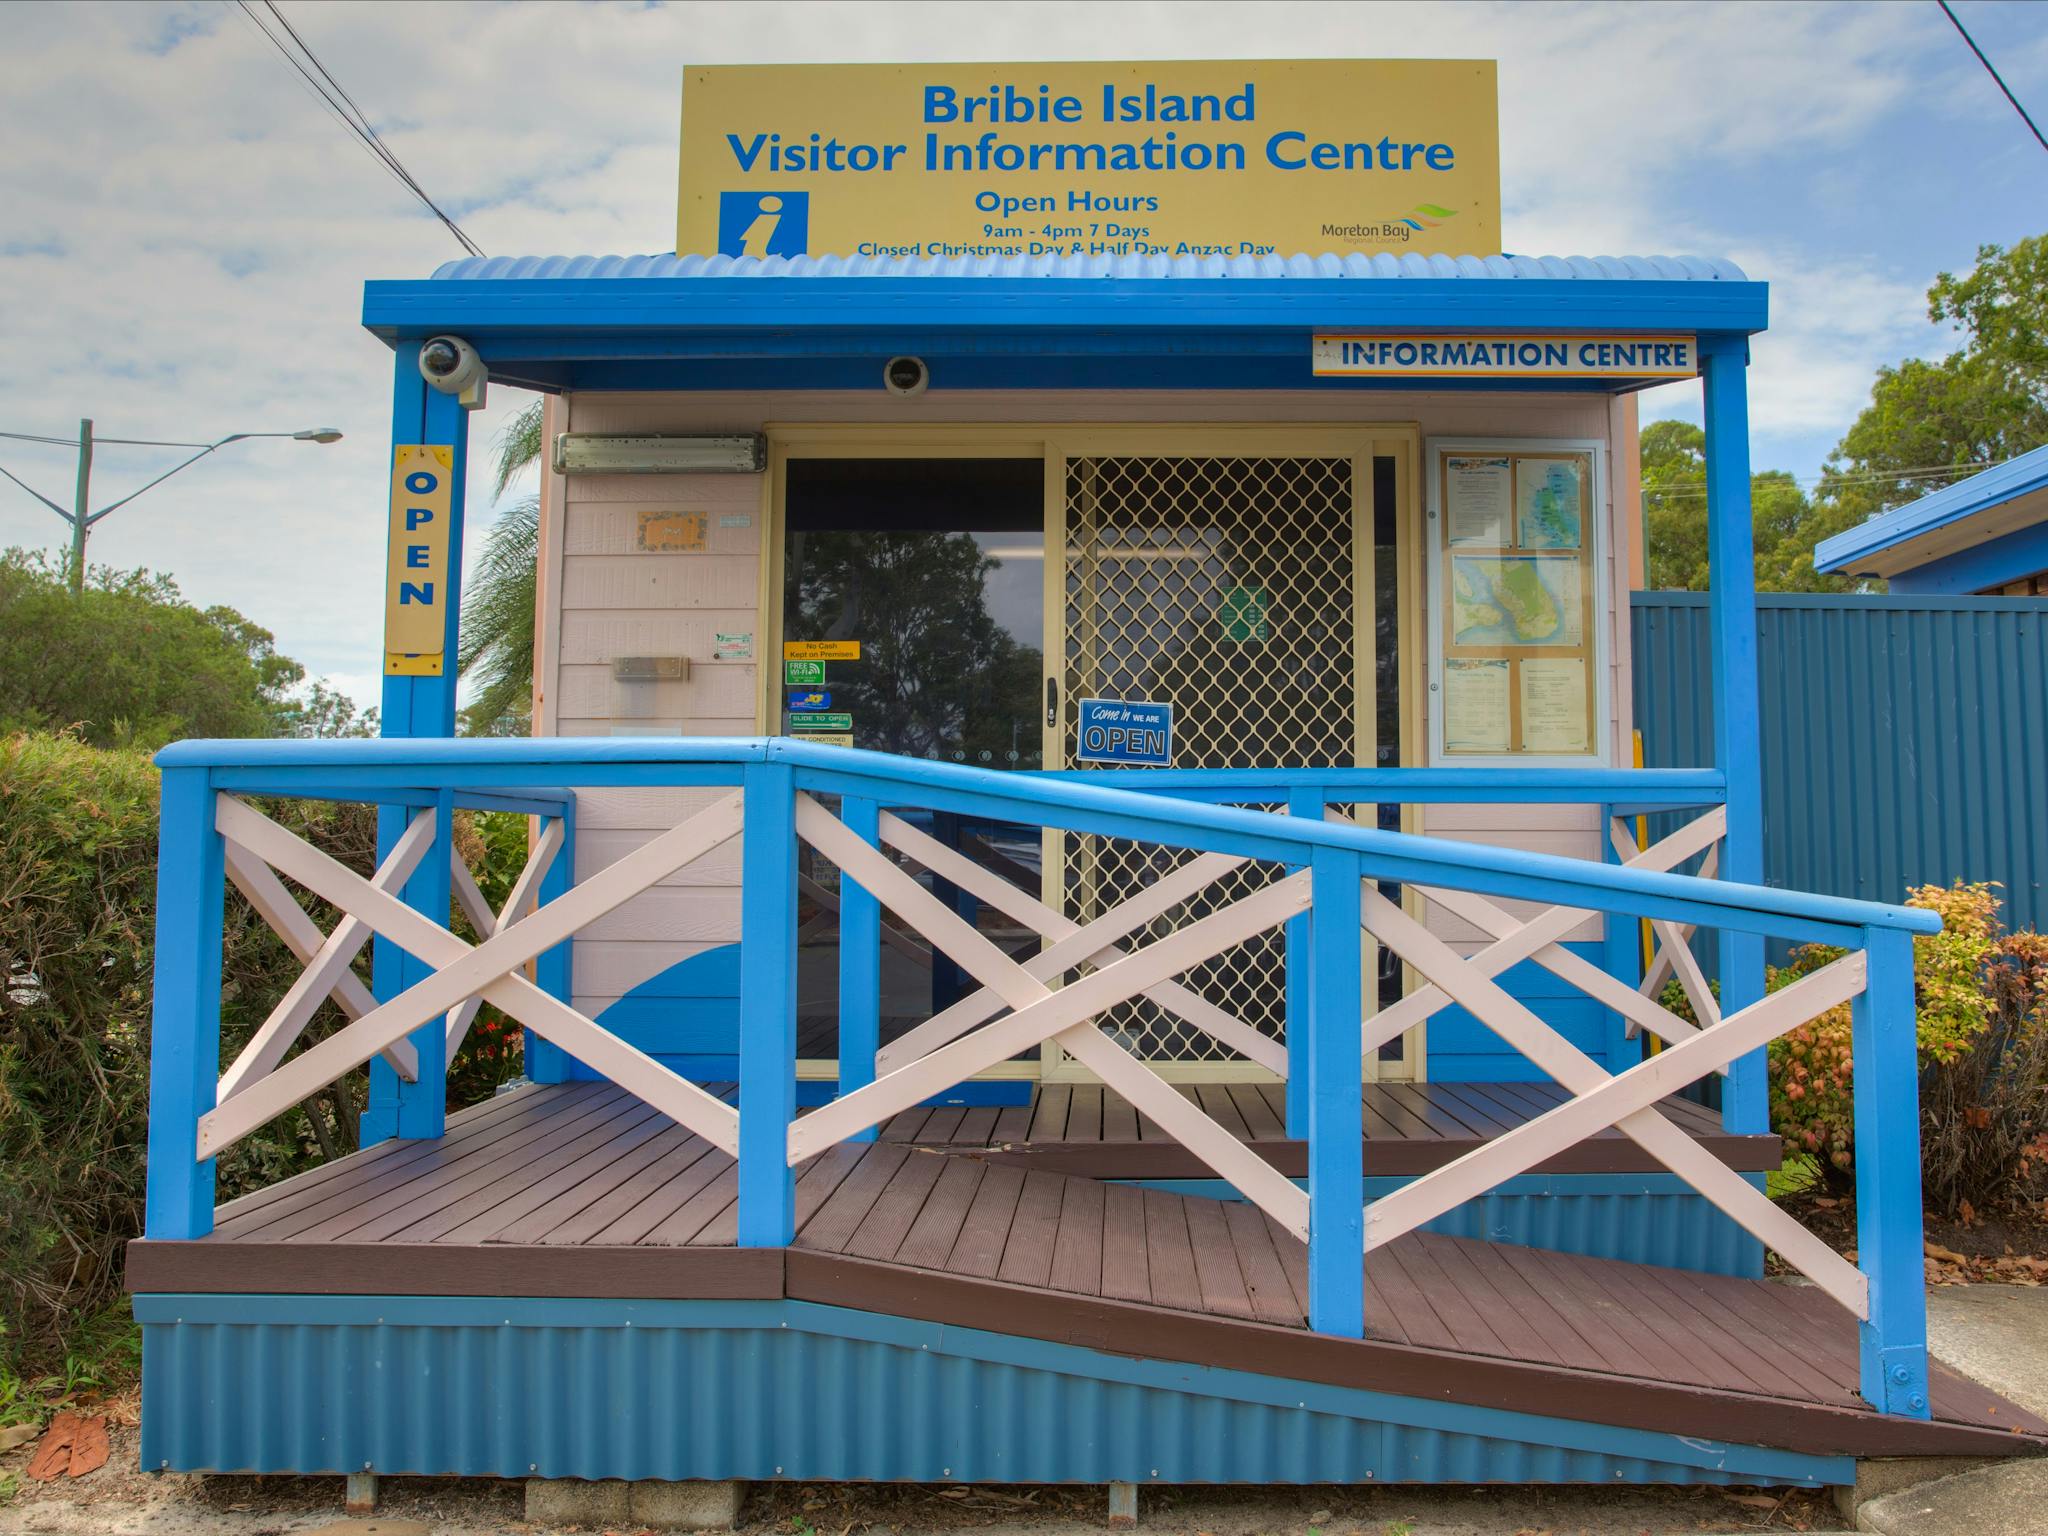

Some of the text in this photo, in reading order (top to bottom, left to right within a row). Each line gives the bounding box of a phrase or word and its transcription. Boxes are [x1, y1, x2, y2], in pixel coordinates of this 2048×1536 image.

[923, 82, 1256, 124] Bribie Island
[725, 130, 1456, 173] Visitor Information Centre
[975, 190, 1159, 218] Open Hours
[983, 223, 1023, 238] 9am
[1041, 223, 1083, 241] 4pm
[1089, 223, 1099, 238] 7
[1106, 223, 1150, 241] Days
[1321, 224, 1410, 241] Moreton Bay
[857, 241, 1275, 256] Closed Christmas Day & Half Day Anzac Day
[1341, 341, 1688, 368] INFORMATION CENTRE
[400, 471, 438, 605] OPEN
[790, 651, 807, 659] Kept
[818, 642, 838, 650] Cash
[1091, 705, 1160, 723] Come in WE ARE
[1084, 725, 1166, 756] OPEN
